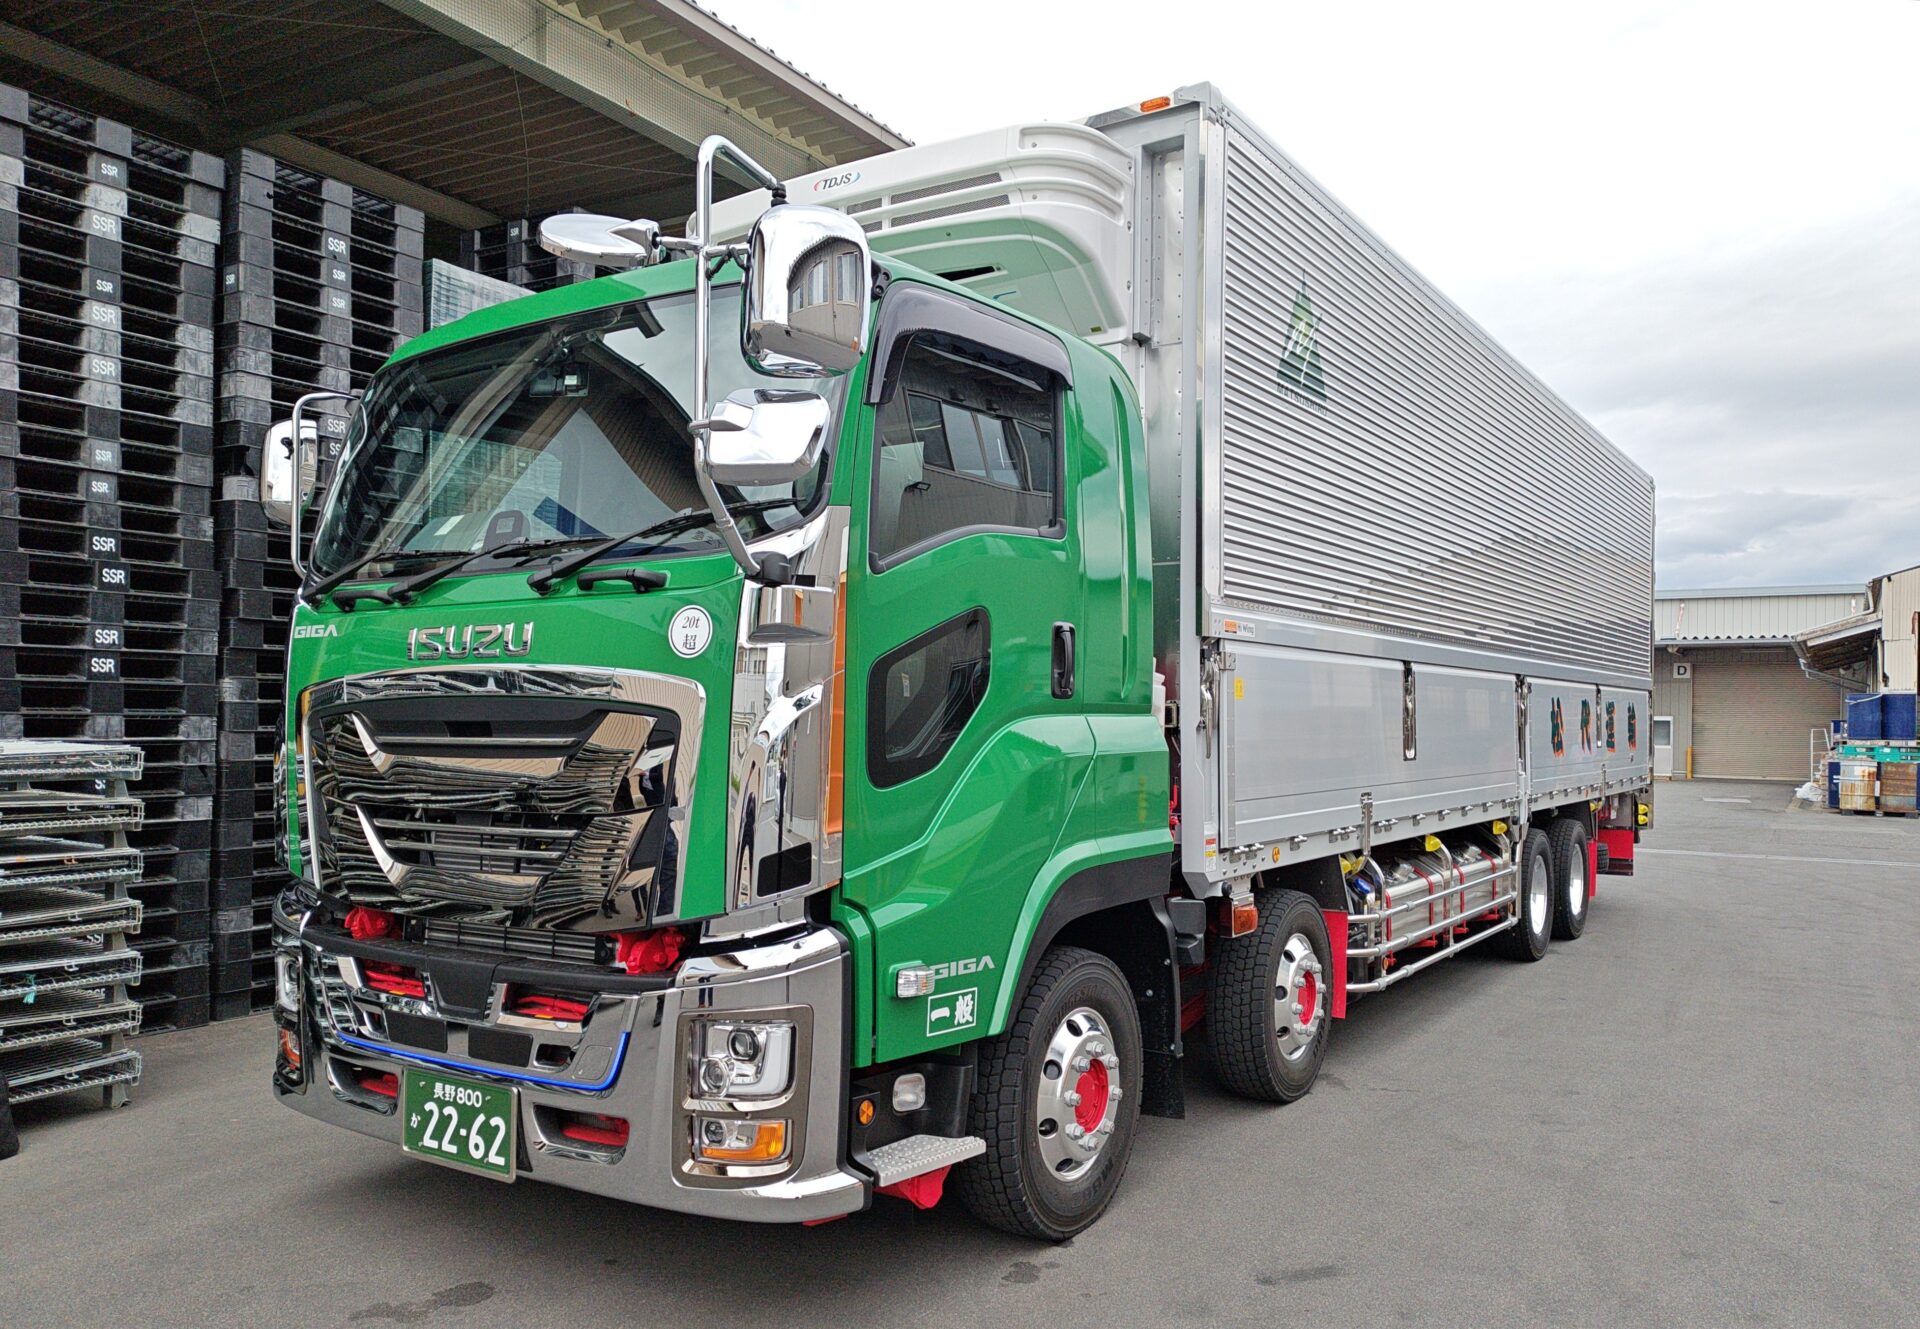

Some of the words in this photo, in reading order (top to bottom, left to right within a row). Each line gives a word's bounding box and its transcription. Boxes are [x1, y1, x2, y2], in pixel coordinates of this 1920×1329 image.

[101, 163, 118, 178] SSR
[822, 173, 852, 190] TDJS
[92, 214, 116, 234] SSR
[327, 237, 346, 255] SSR
[332, 269, 346, 281] SSR
[96, 279, 113, 294] SSR
[332, 297, 346, 309] SSR
[92, 305, 116, 325] SSR
[92, 359, 116, 377] SSR
[327, 419, 346, 433] SSR
[95, 448, 112, 463] SSR
[329, 443, 341, 456] SS
[91, 481, 109, 493] SSR
[92, 536, 116, 552] SSR
[102, 568, 125, 585] SSR
[682, 616, 700, 628] 20t
[95, 629, 119, 645] SSR
[294, 624, 338, 638] GIGA
[407, 621, 534, 660] ISUZU
[682, 633, 697, 650] 超
[91, 658, 115, 673] SSR
[1678, 665, 1688, 676] D
[929, 955, 995, 980] GIGA
[931, 993, 974, 1026] 一般
[410, 1112, 421, 1129] か
[423, 1101, 506, 1166] 22-62
